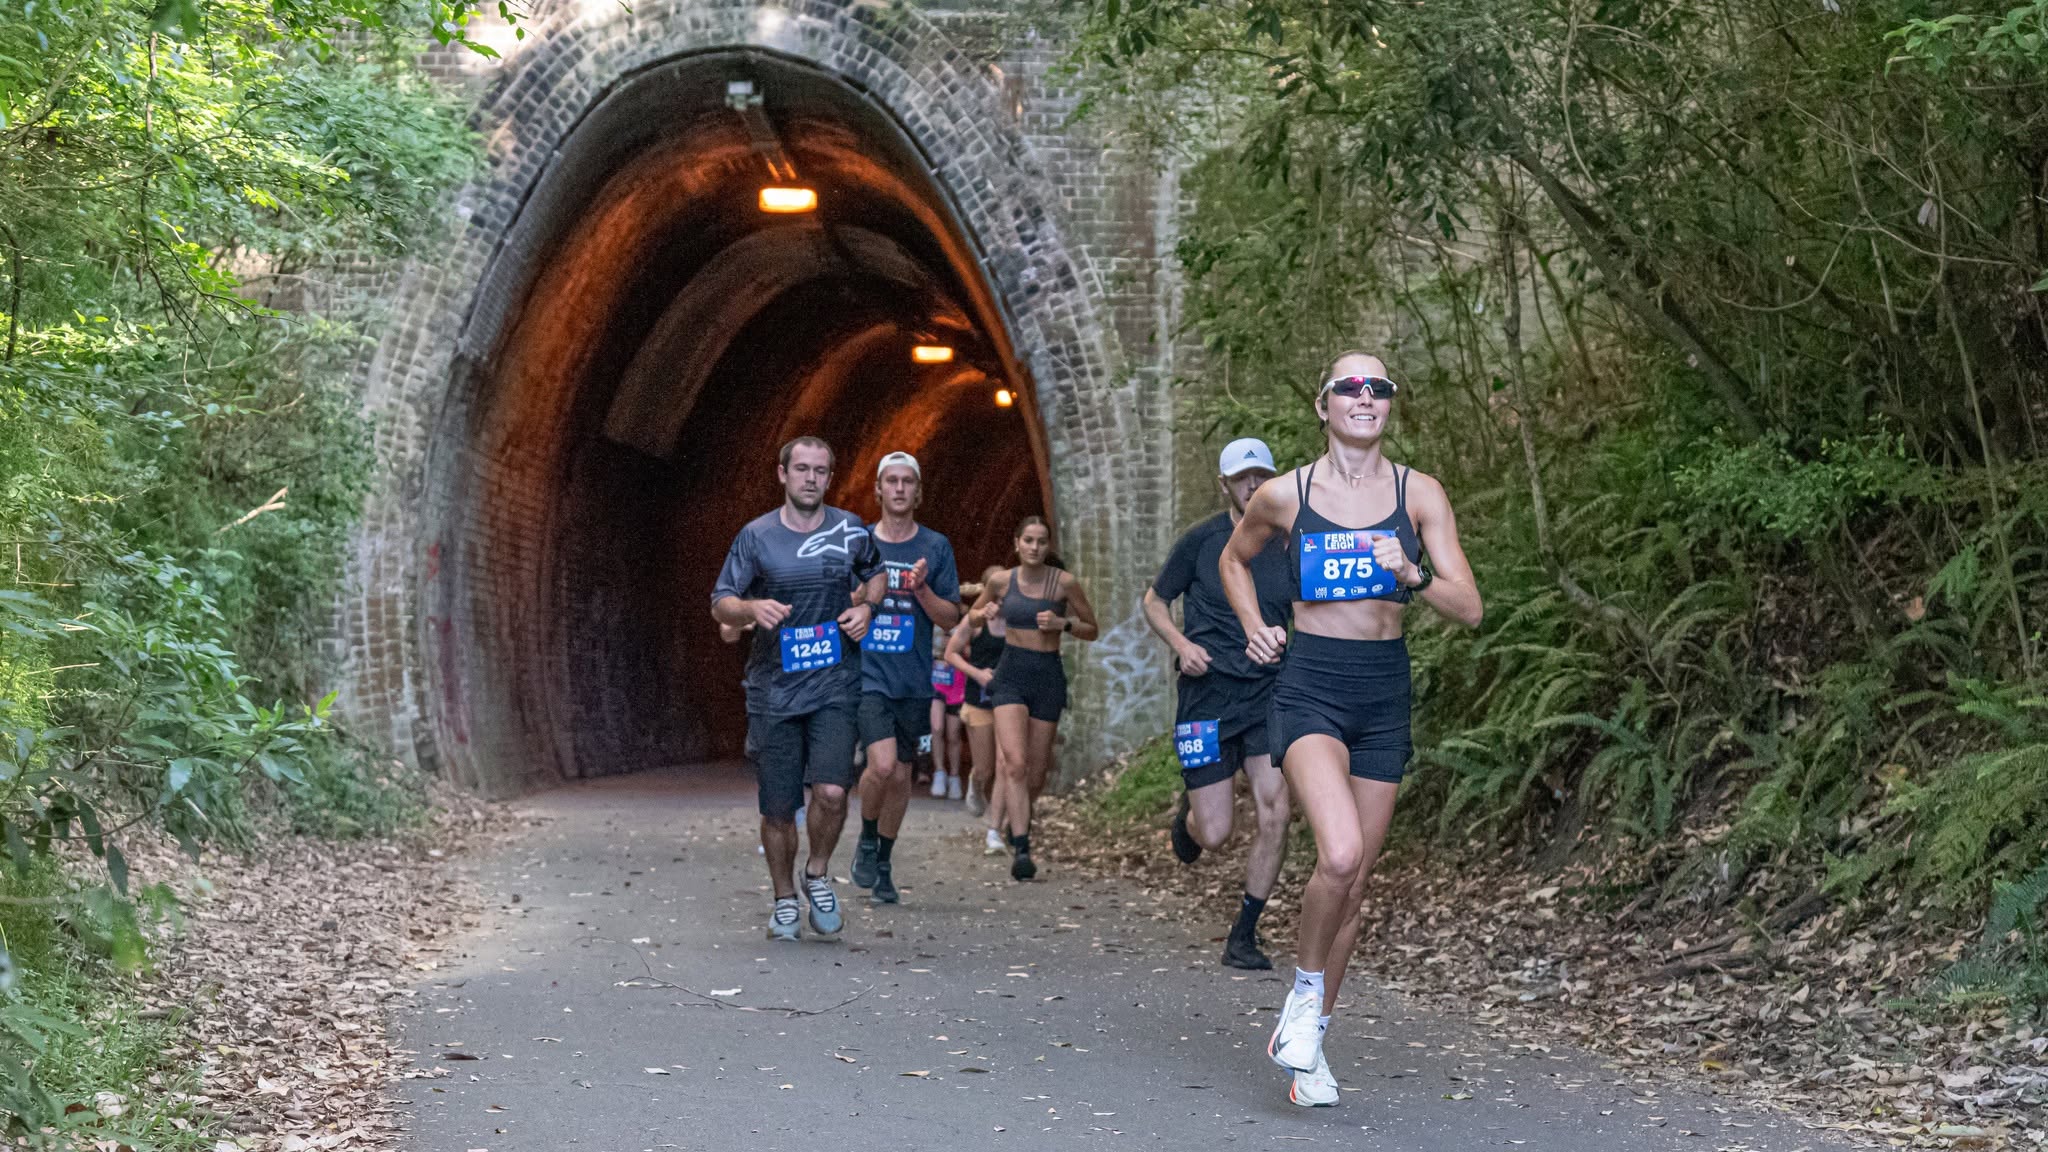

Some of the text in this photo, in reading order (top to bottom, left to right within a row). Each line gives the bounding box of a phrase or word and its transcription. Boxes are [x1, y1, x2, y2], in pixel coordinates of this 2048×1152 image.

[1325, 533, 1354, 542] FERN
[1325, 541, 1354, 550] LEIGH
[1323, 557, 1373, 580] 875
[873, 628, 901, 641] 957
[791, 640, 832, 658] 1242
[1178, 739, 1204, 756] 968
